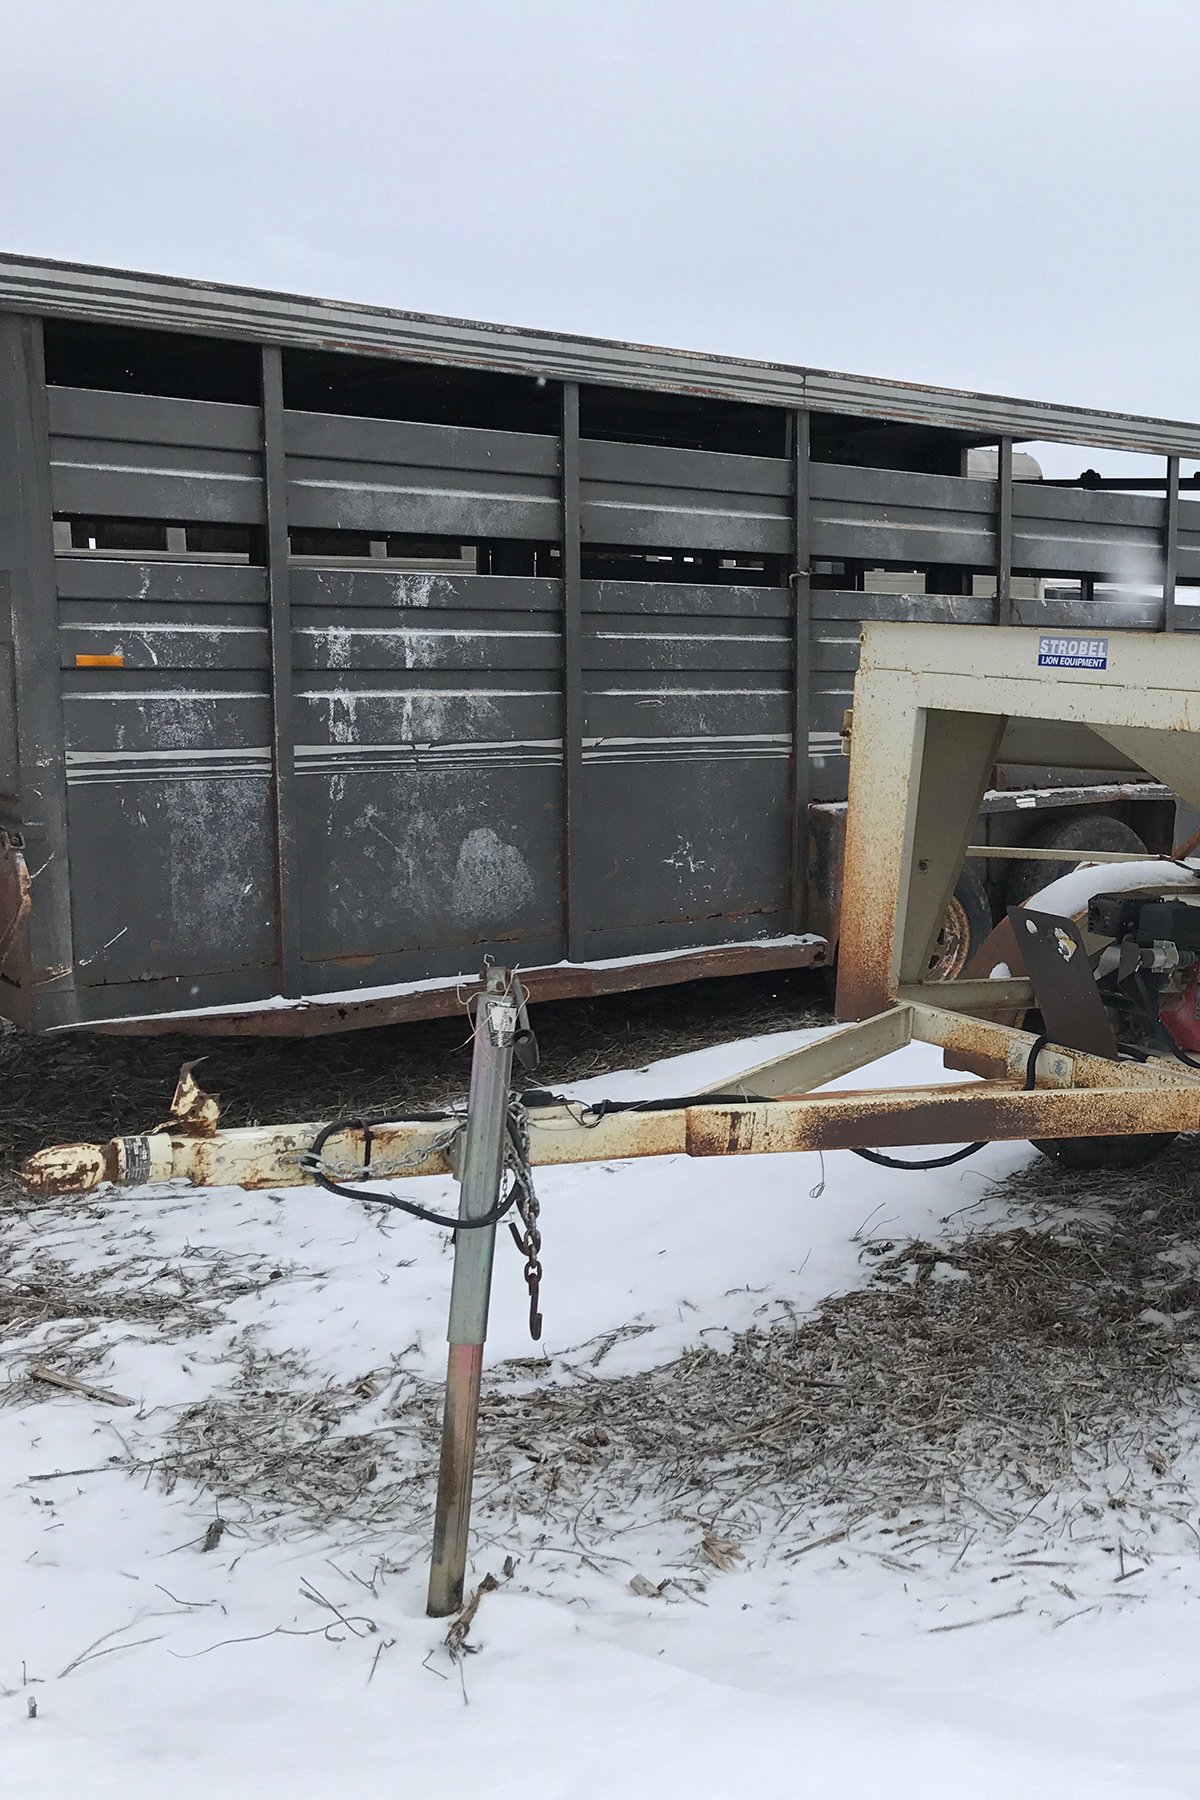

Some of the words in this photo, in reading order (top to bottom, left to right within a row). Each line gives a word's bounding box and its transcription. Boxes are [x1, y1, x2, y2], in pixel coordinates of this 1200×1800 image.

[1040, 639, 1106, 656] STROBEL
[1041, 656, 1058, 665] LION
[1059, 657, 1104, 667] EQUIPMENT
